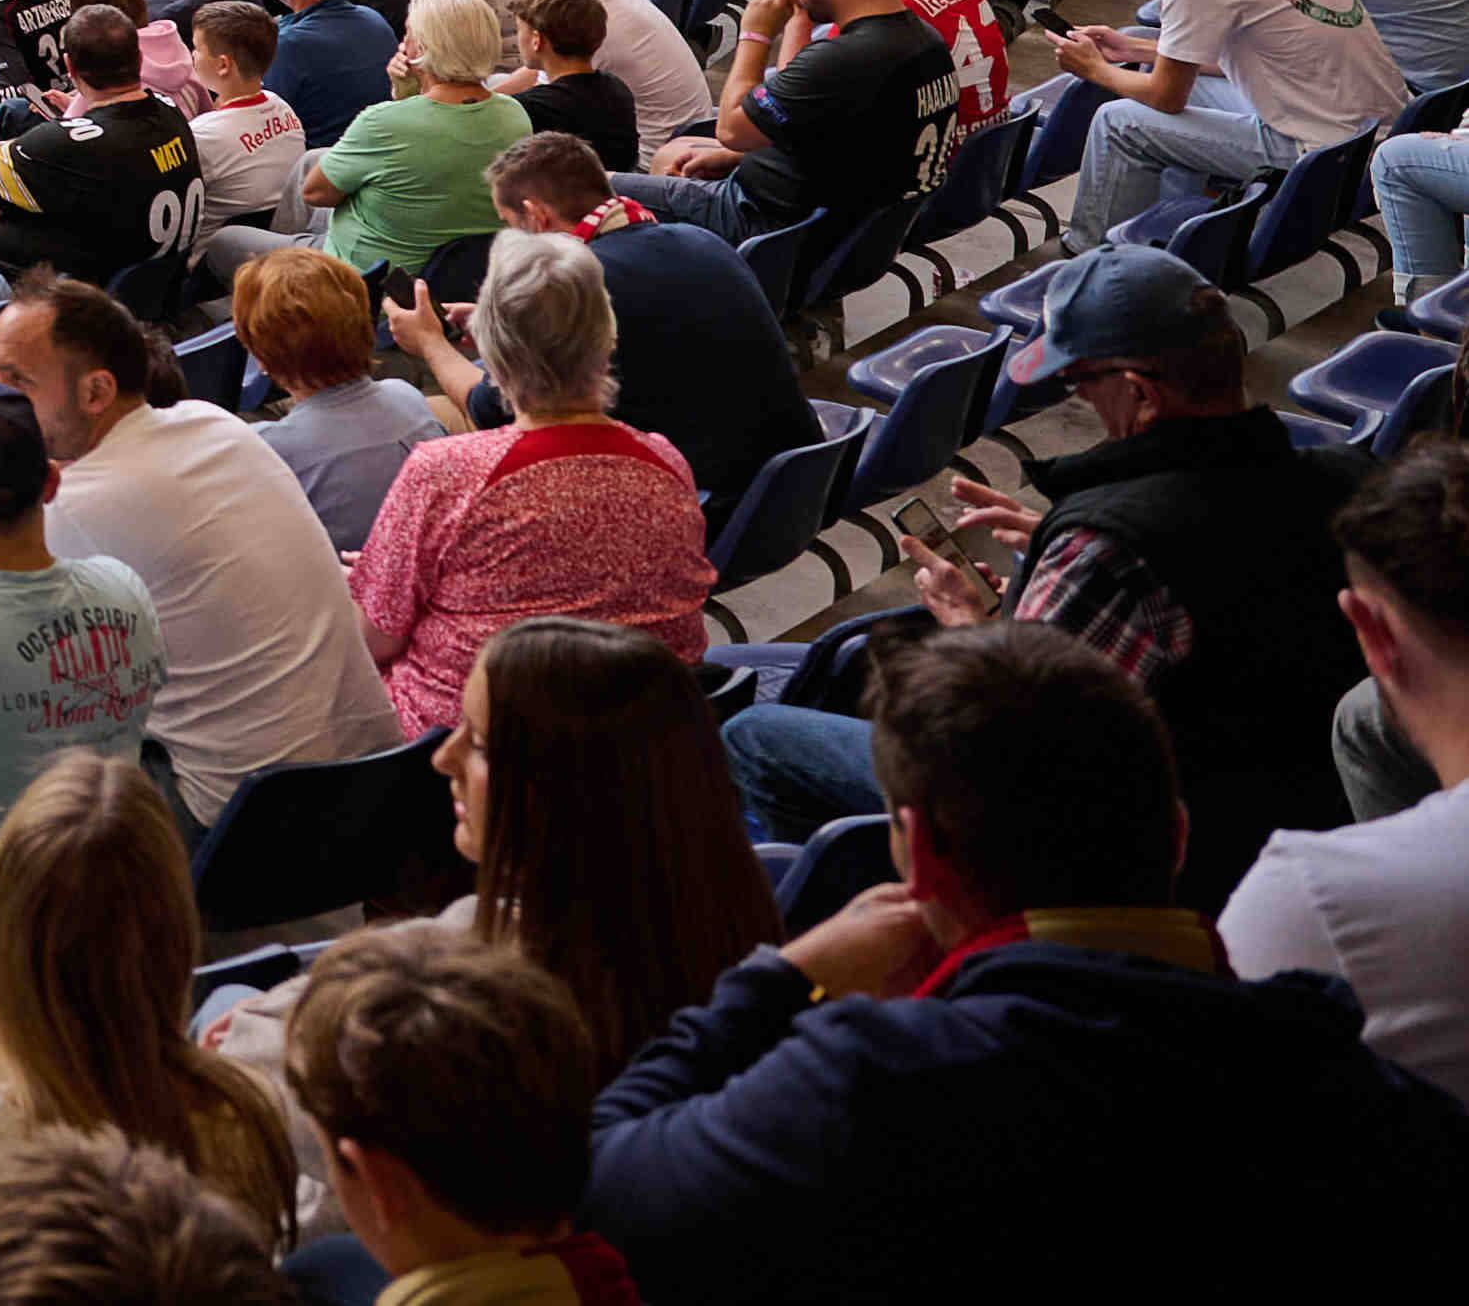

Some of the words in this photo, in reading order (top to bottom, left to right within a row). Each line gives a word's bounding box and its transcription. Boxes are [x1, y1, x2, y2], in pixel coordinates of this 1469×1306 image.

[149, 136, 190, 174] WATT
[240, 119, 273, 153] Red
[148, 177, 205, 257] 90
[16, 612, 79, 663] OCEAN
[80, 605, 139, 640] SPIRIT
